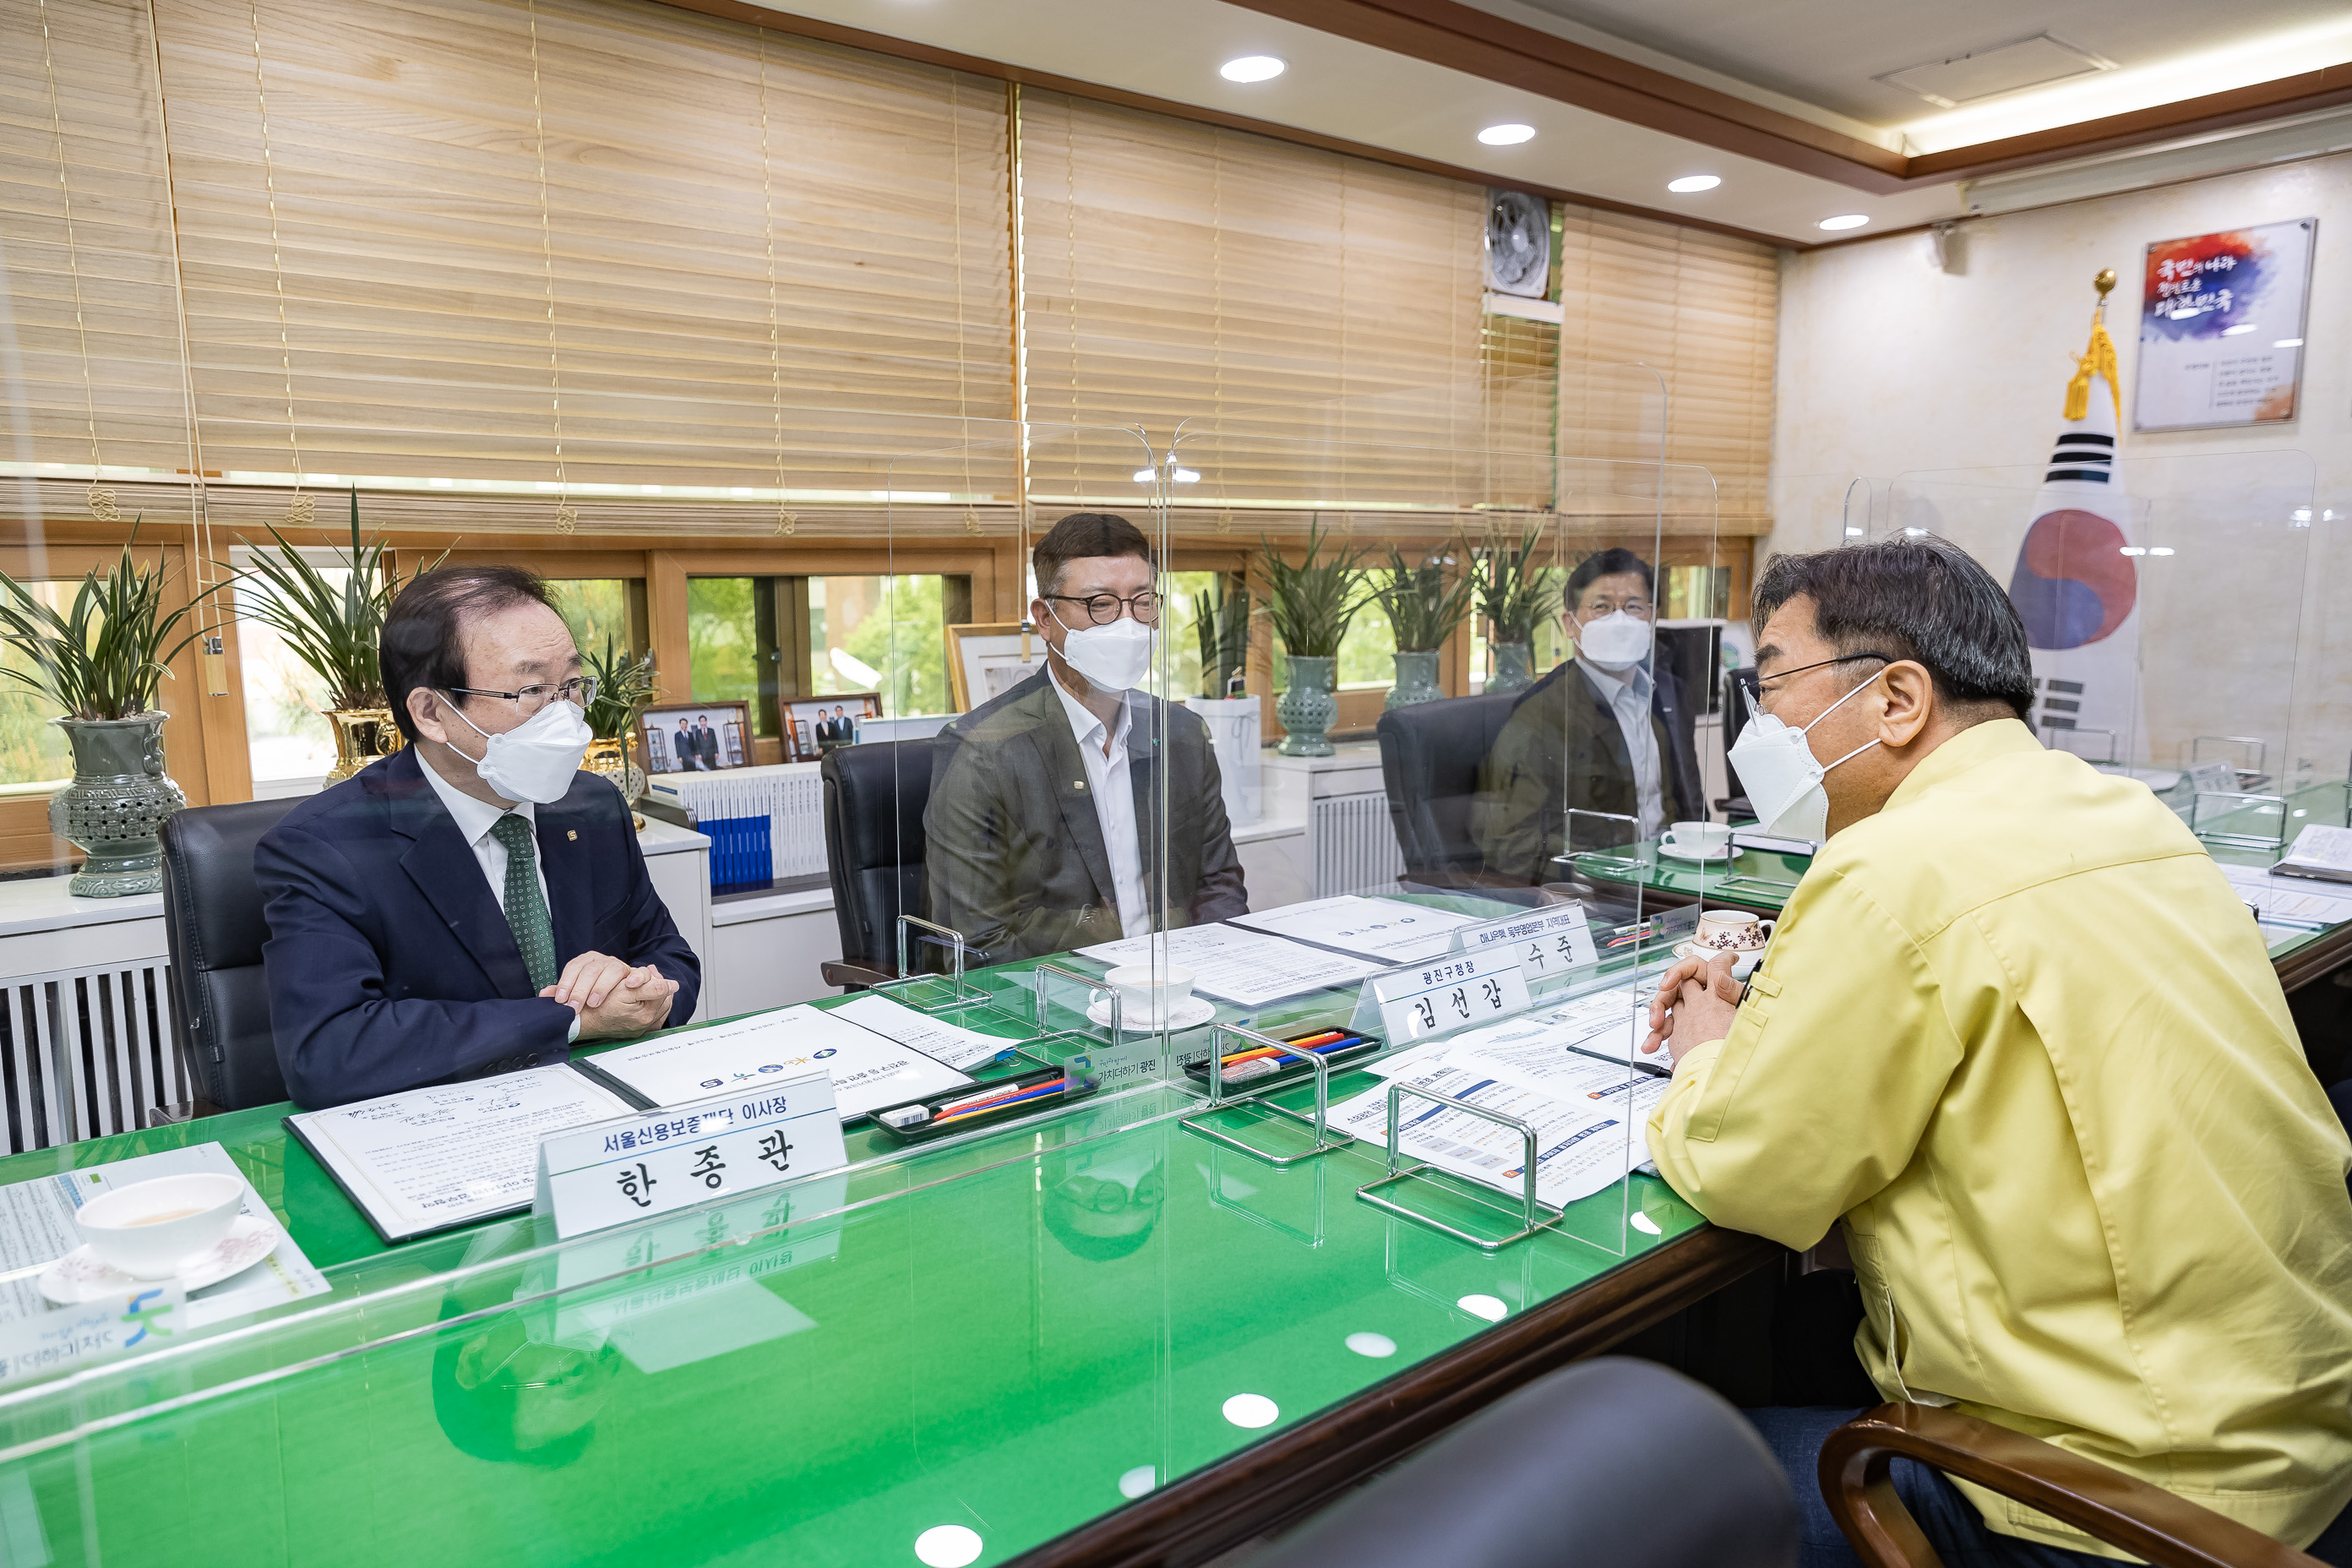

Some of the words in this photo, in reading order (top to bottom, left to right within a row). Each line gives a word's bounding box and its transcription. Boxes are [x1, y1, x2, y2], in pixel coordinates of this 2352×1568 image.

[2205, 254, 2238, 272] 나라
[2153, 289, 2234, 318] 대한민국
[1507, 920, 1545, 939] 동부영업본부
[1546, 914, 1571, 928] 지역대표
[1527, 943, 1544, 970] 수
[1557, 935, 1573, 963] 준
[1423, 961, 1475, 985] 광진구청장
[1415, 997, 1437, 1030] 김
[1451, 988, 1470, 1019] 선
[1484, 978, 1502, 1010] 갑
[1098, 1063, 1139, 1082] 가치더하기
[1140, 1059, 1156, 1073] 광진
[742, 1096, 787, 1120] 이사장
[616, 1162, 657, 1207] 한
[689, 1145, 727, 1190] 종
[758, 1130, 794, 1173] 관
